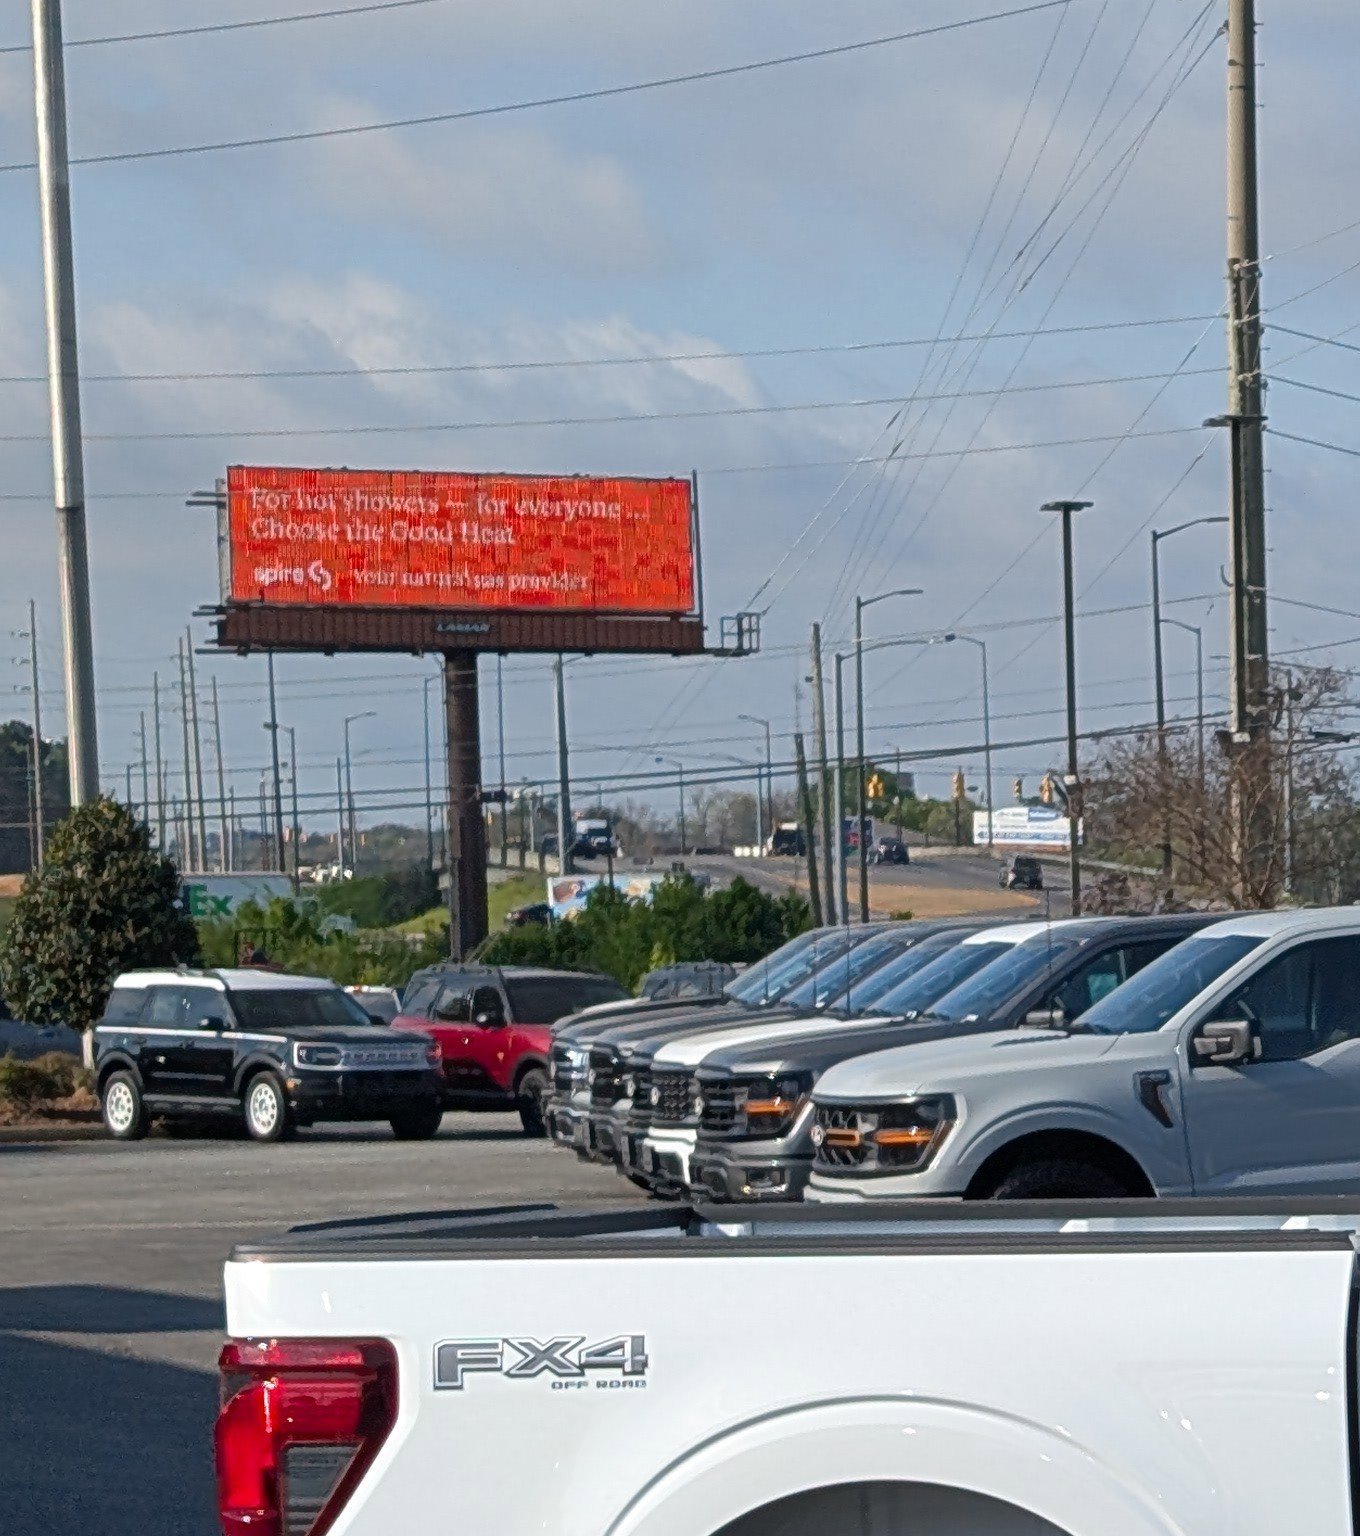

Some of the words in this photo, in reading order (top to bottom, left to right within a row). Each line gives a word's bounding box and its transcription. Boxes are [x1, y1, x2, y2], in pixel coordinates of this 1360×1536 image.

[251, 487, 291, 510] For
[296, 487, 336, 512] hot
[343, 489, 439, 514] showers
[477, 492, 508, 516] for
[515, 499, 621, 522] everyone
[251, 516, 340, 542] Choose
[345, 517, 385, 543] the
[434, 1335, 649, 1391] FX4
[551, 1380, 589, 1390] OFF
[596, 1379, 648, 1390] ROAD
